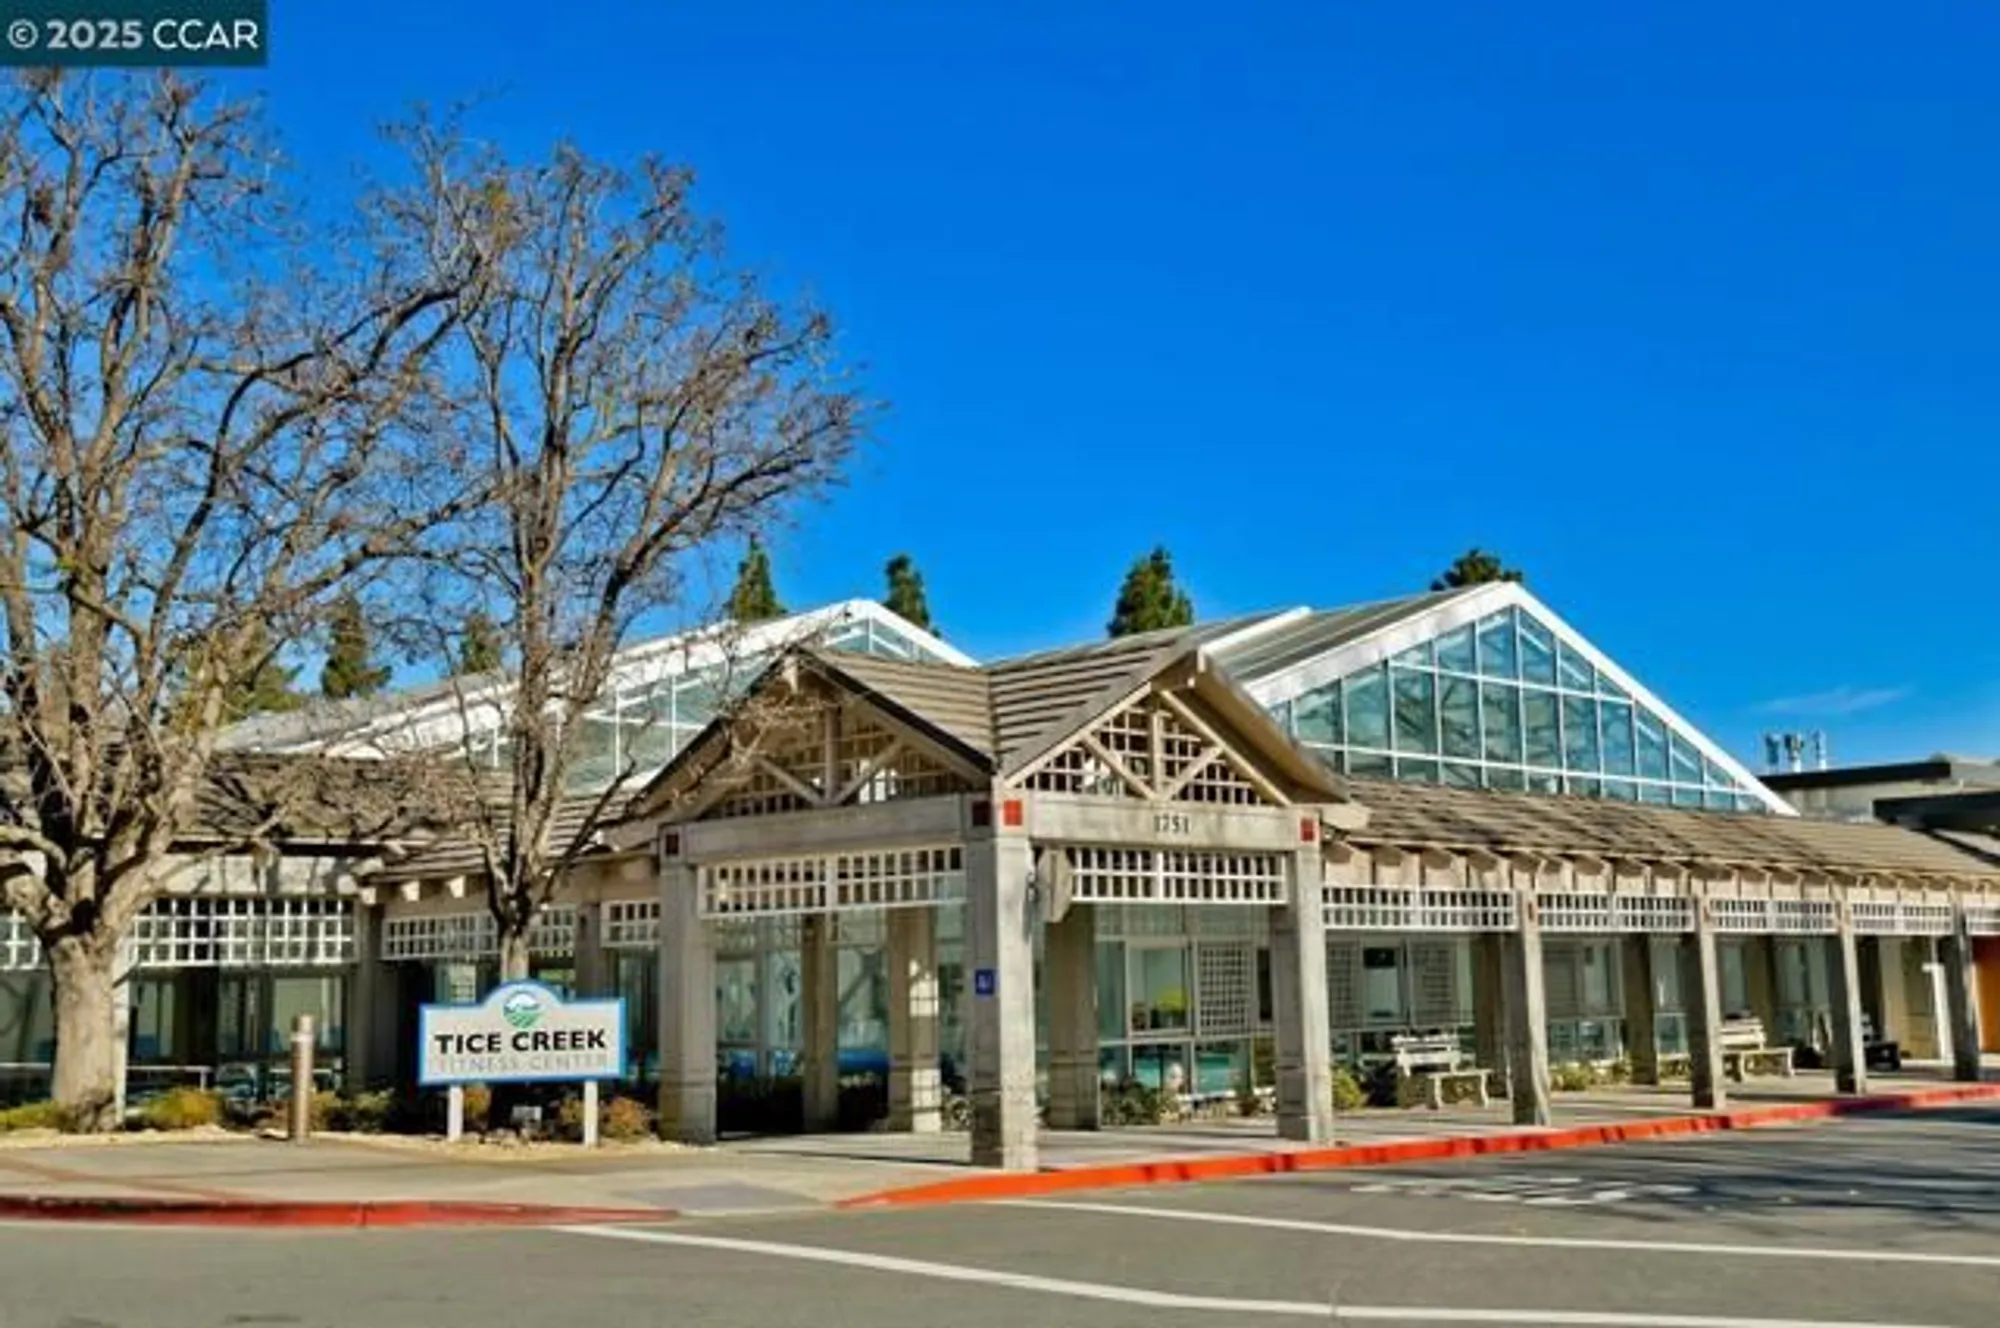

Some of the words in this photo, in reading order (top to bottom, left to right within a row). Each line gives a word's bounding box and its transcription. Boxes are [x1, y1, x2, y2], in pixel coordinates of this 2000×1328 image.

[1153, 813, 1189, 834] 1751
[434, 1034, 501, 1054] TICE
[511, 1029, 606, 1051] CREEK
